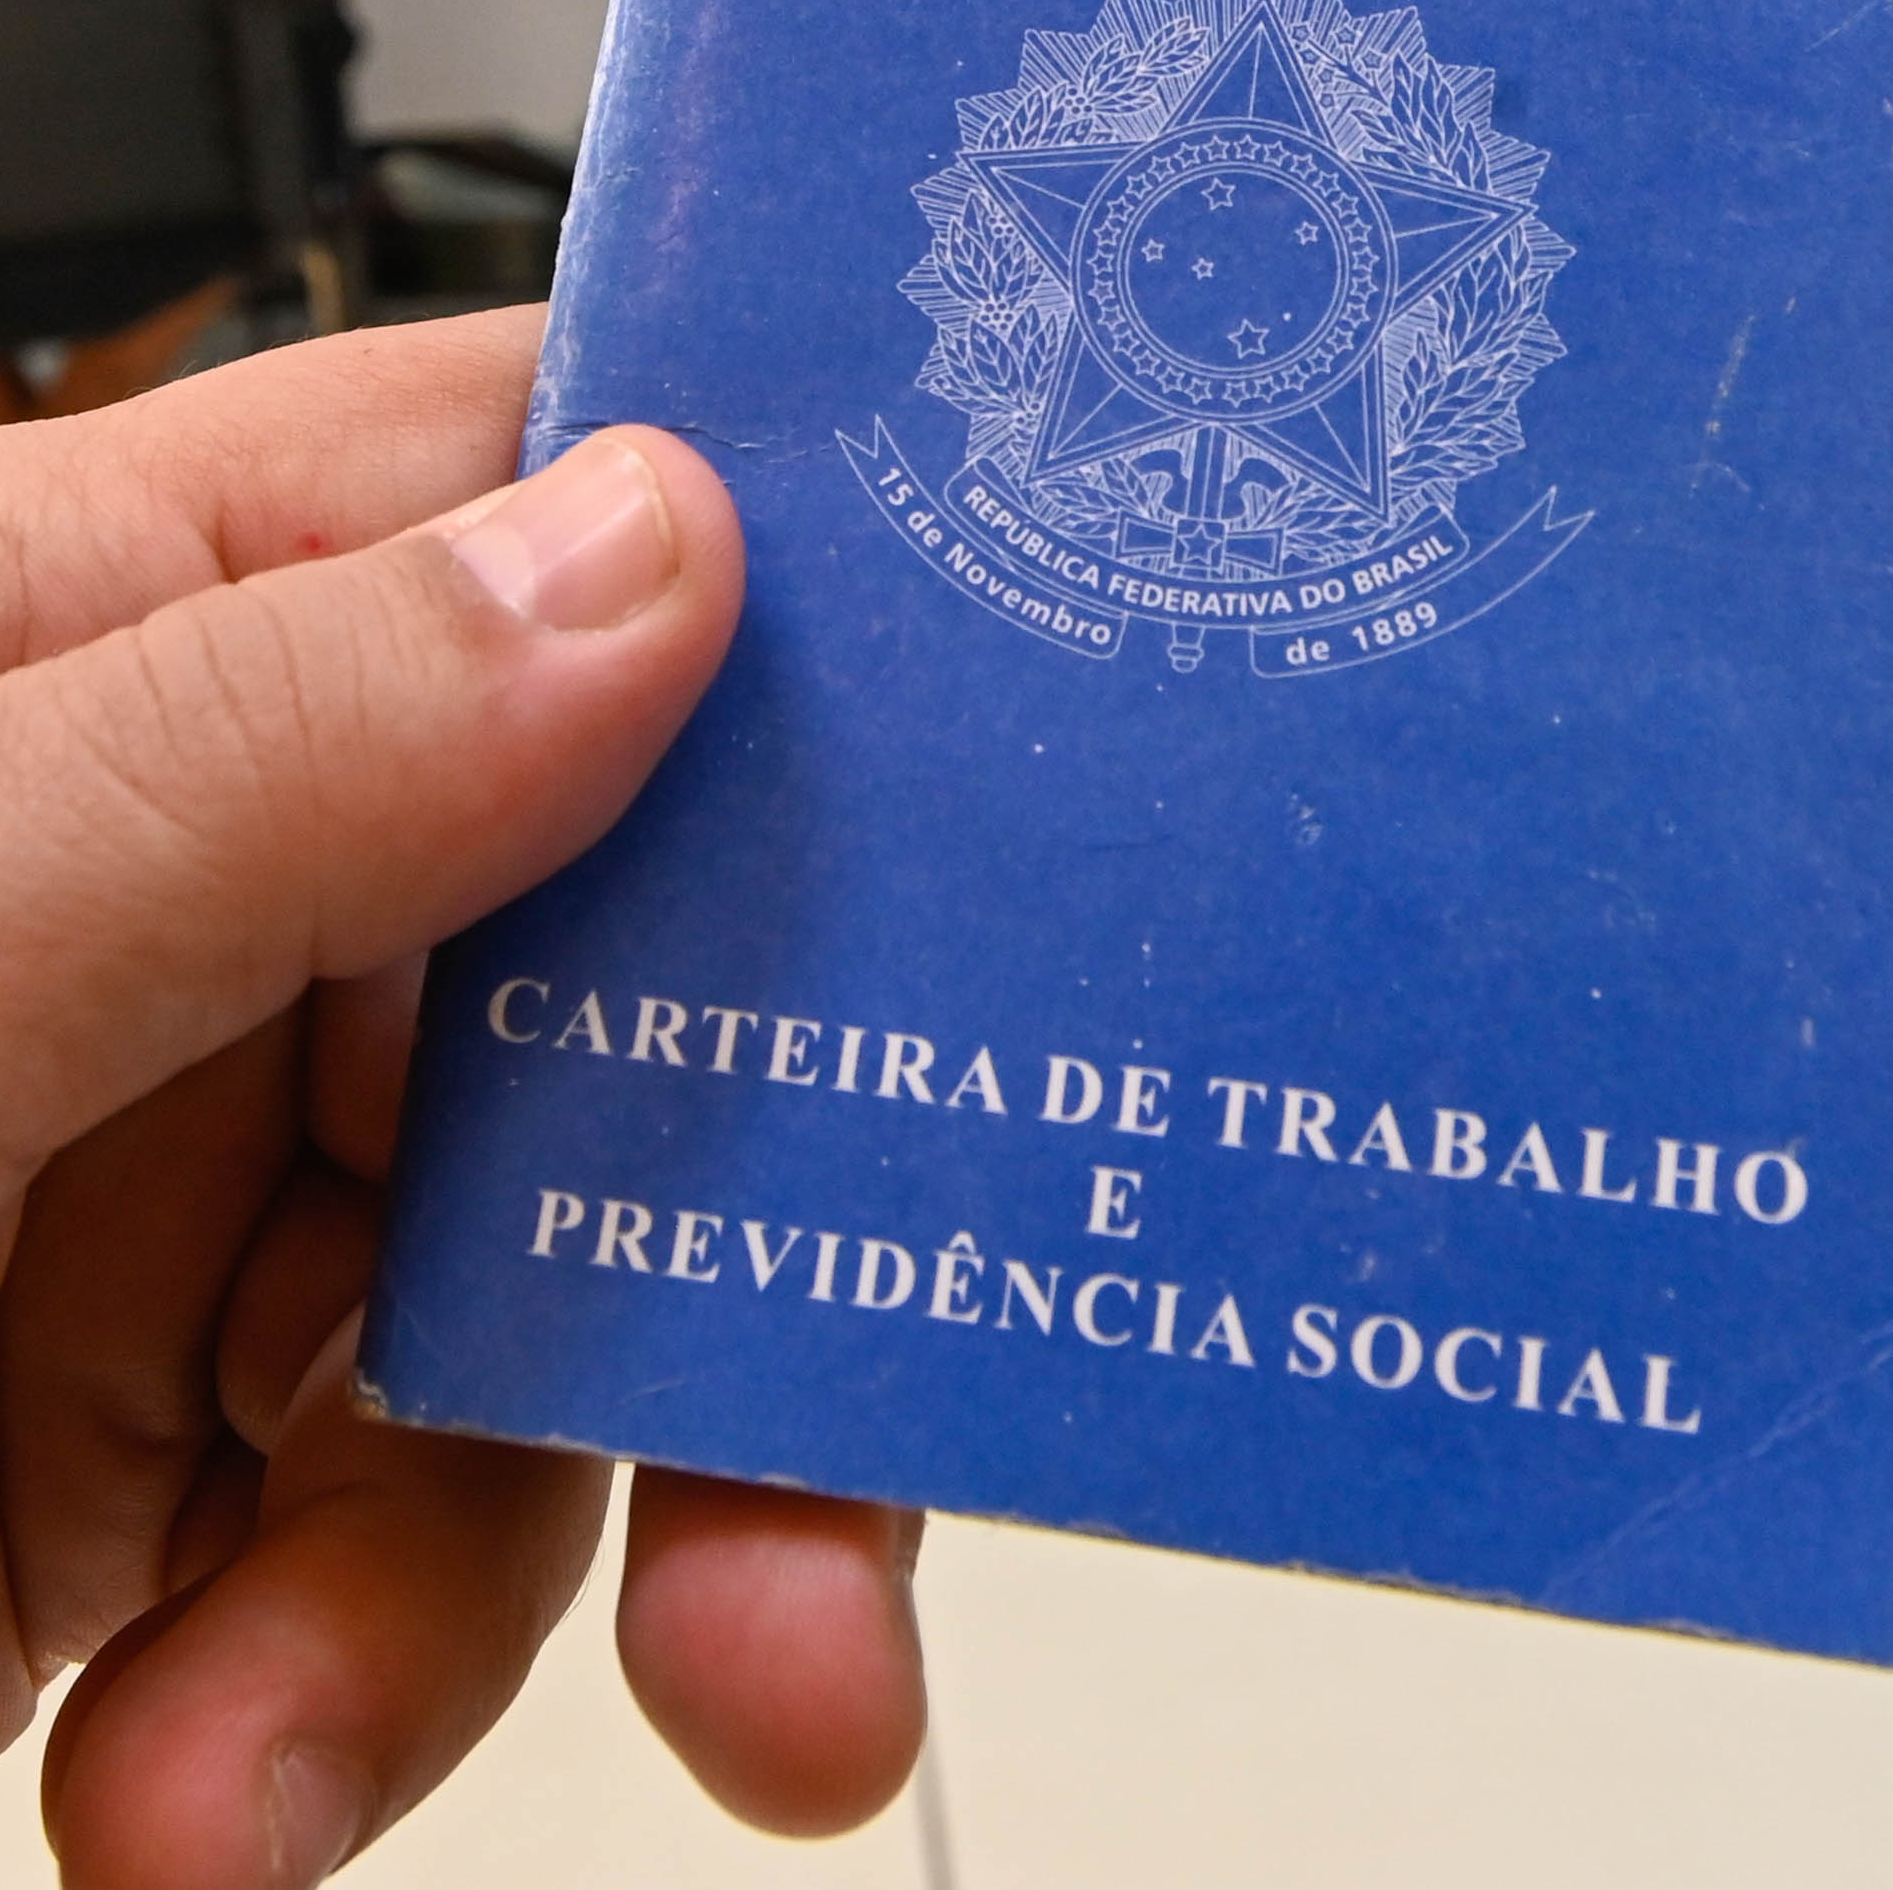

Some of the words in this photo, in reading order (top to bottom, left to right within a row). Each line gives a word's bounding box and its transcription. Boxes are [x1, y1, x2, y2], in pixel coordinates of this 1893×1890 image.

[876, 465, 911, 508] 15
[907, 508, 944, 548] de
[942, 540, 1112, 646] Novembro
[963, 484, 1101, 590] REPÚBLICA
[1107, 574, 1293, 618] FEDERATIVA
[1299, 582, 1346, 611] DO
[1353, 537, 1453, 594] BRASIL
[1285, 636, 1331, 666] de
[1351, 601, 1440, 652] 1889
[486, 976, 1007, 1115] CARTEIRA
[1042, 1056, 1170, 1136] DE
[1209, 1078, 1807, 1223] TRABALHO
[1089, 1167, 1141, 1238] E
[527, 1186, 1255, 1368] PREVIDÊNCIA
[1288, 1305, 1699, 1433] SOCIAL
